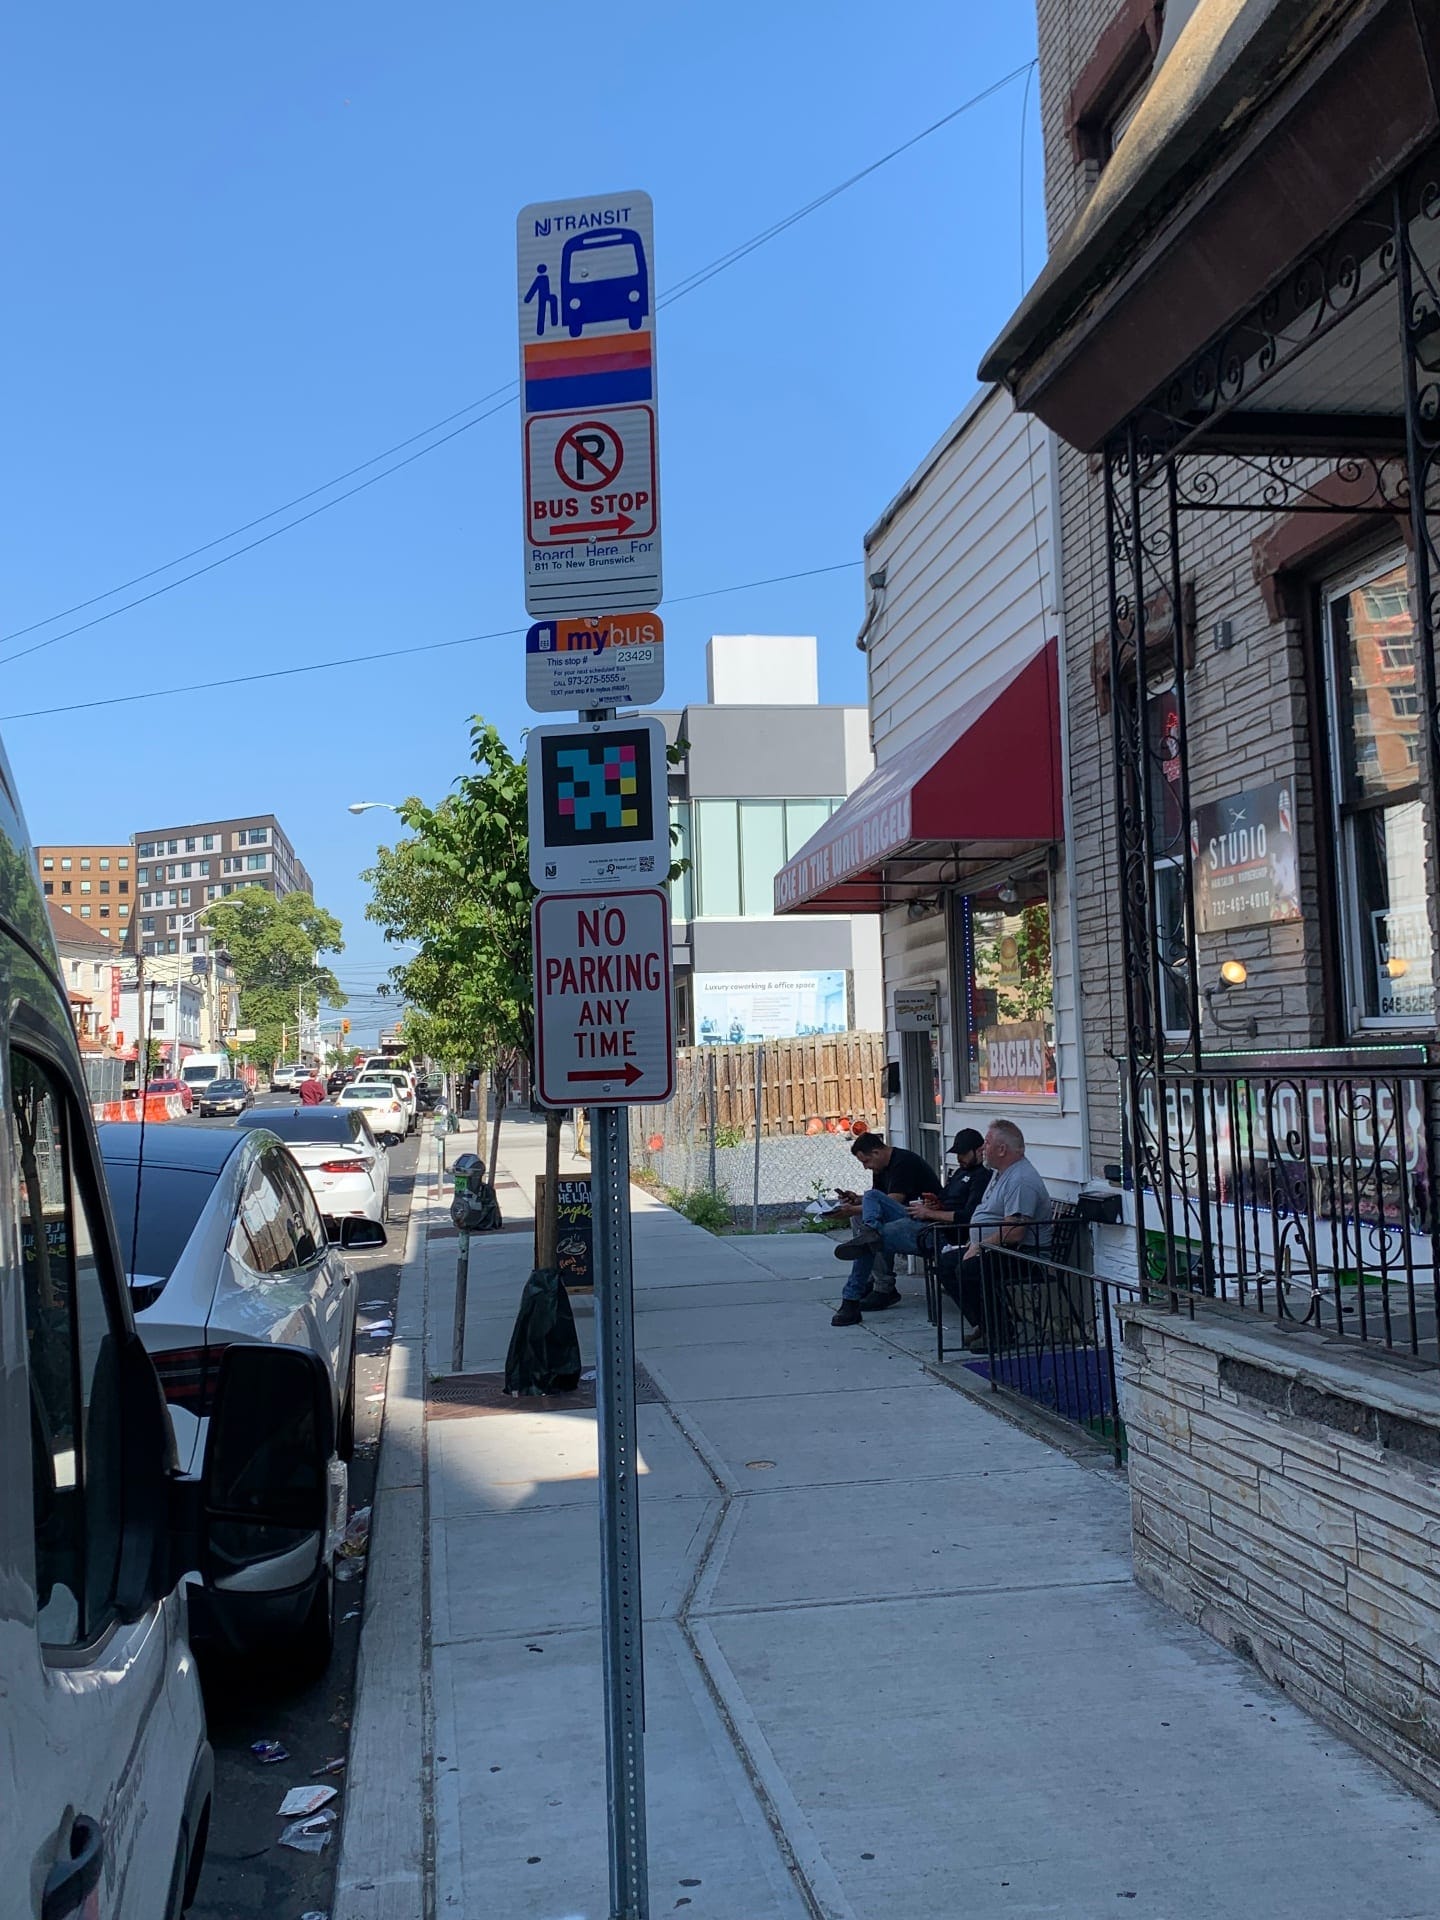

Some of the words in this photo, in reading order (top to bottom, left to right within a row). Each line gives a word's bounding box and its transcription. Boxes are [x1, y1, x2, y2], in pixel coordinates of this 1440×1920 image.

[554, 208, 632, 231] TRANSIT
[533, 498, 579, 519] BUS
[590, 491, 649, 515] STOP
[532, 547, 574, 561] Board
[586, 544, 619, 557] Here
[630, 540, 653, 553] For
[534, 562, 549, 571] 811
[552, 560, 562, 570] To
[566, 559, 585, 568] New
[589, 555, 635, 567] Brunswick
[547, 658, 563, 666] This
[564, 657, 581, 666] stop
[582, 656, 588, 664] #
[617, 650, 652, 662] 23429
[567, 673, 620, 685] 973-275-5555
[863, 793, 911, 860] BAGELS
[1209, 823, 1267, 870] STUDIO
[577, 908, 626, 948] NO
[546, 952, 660, 996] PARKING
[705, 983, 730, 991] Luxury
[730, 982, 766, 991] coworking
[795, 982, 815, 990] space
[578, 999, 630, 1026] ANY
[573, 1030, 637, 1058] TIME
[989, 1039, 1042, 1077] BAGELS
[558, 1182, 573, 1193] LE
[575, 1181, 587, 1193] IN
[558, 1192, 572, 1204] HE
